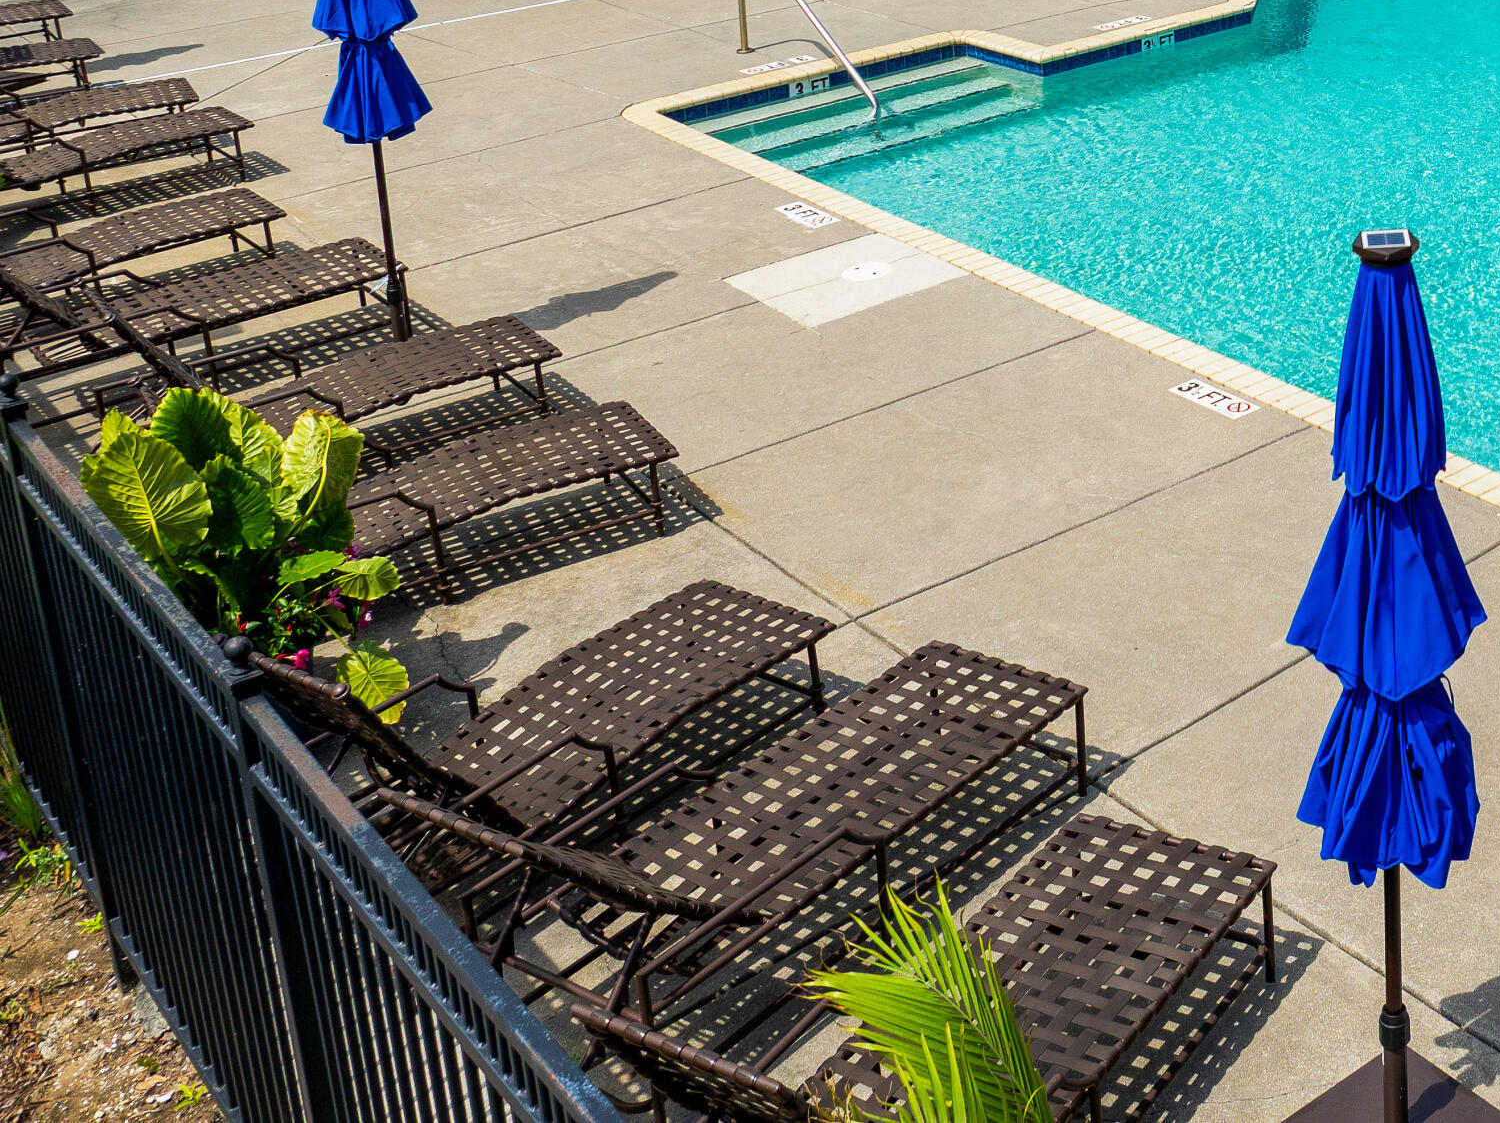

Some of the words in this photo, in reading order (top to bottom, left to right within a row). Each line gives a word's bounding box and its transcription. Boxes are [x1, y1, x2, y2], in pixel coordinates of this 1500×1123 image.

[1159, 34, 1173, 45] FT
[811, 77, 828, 91] FT
[783, 204, 803, 212] 3
